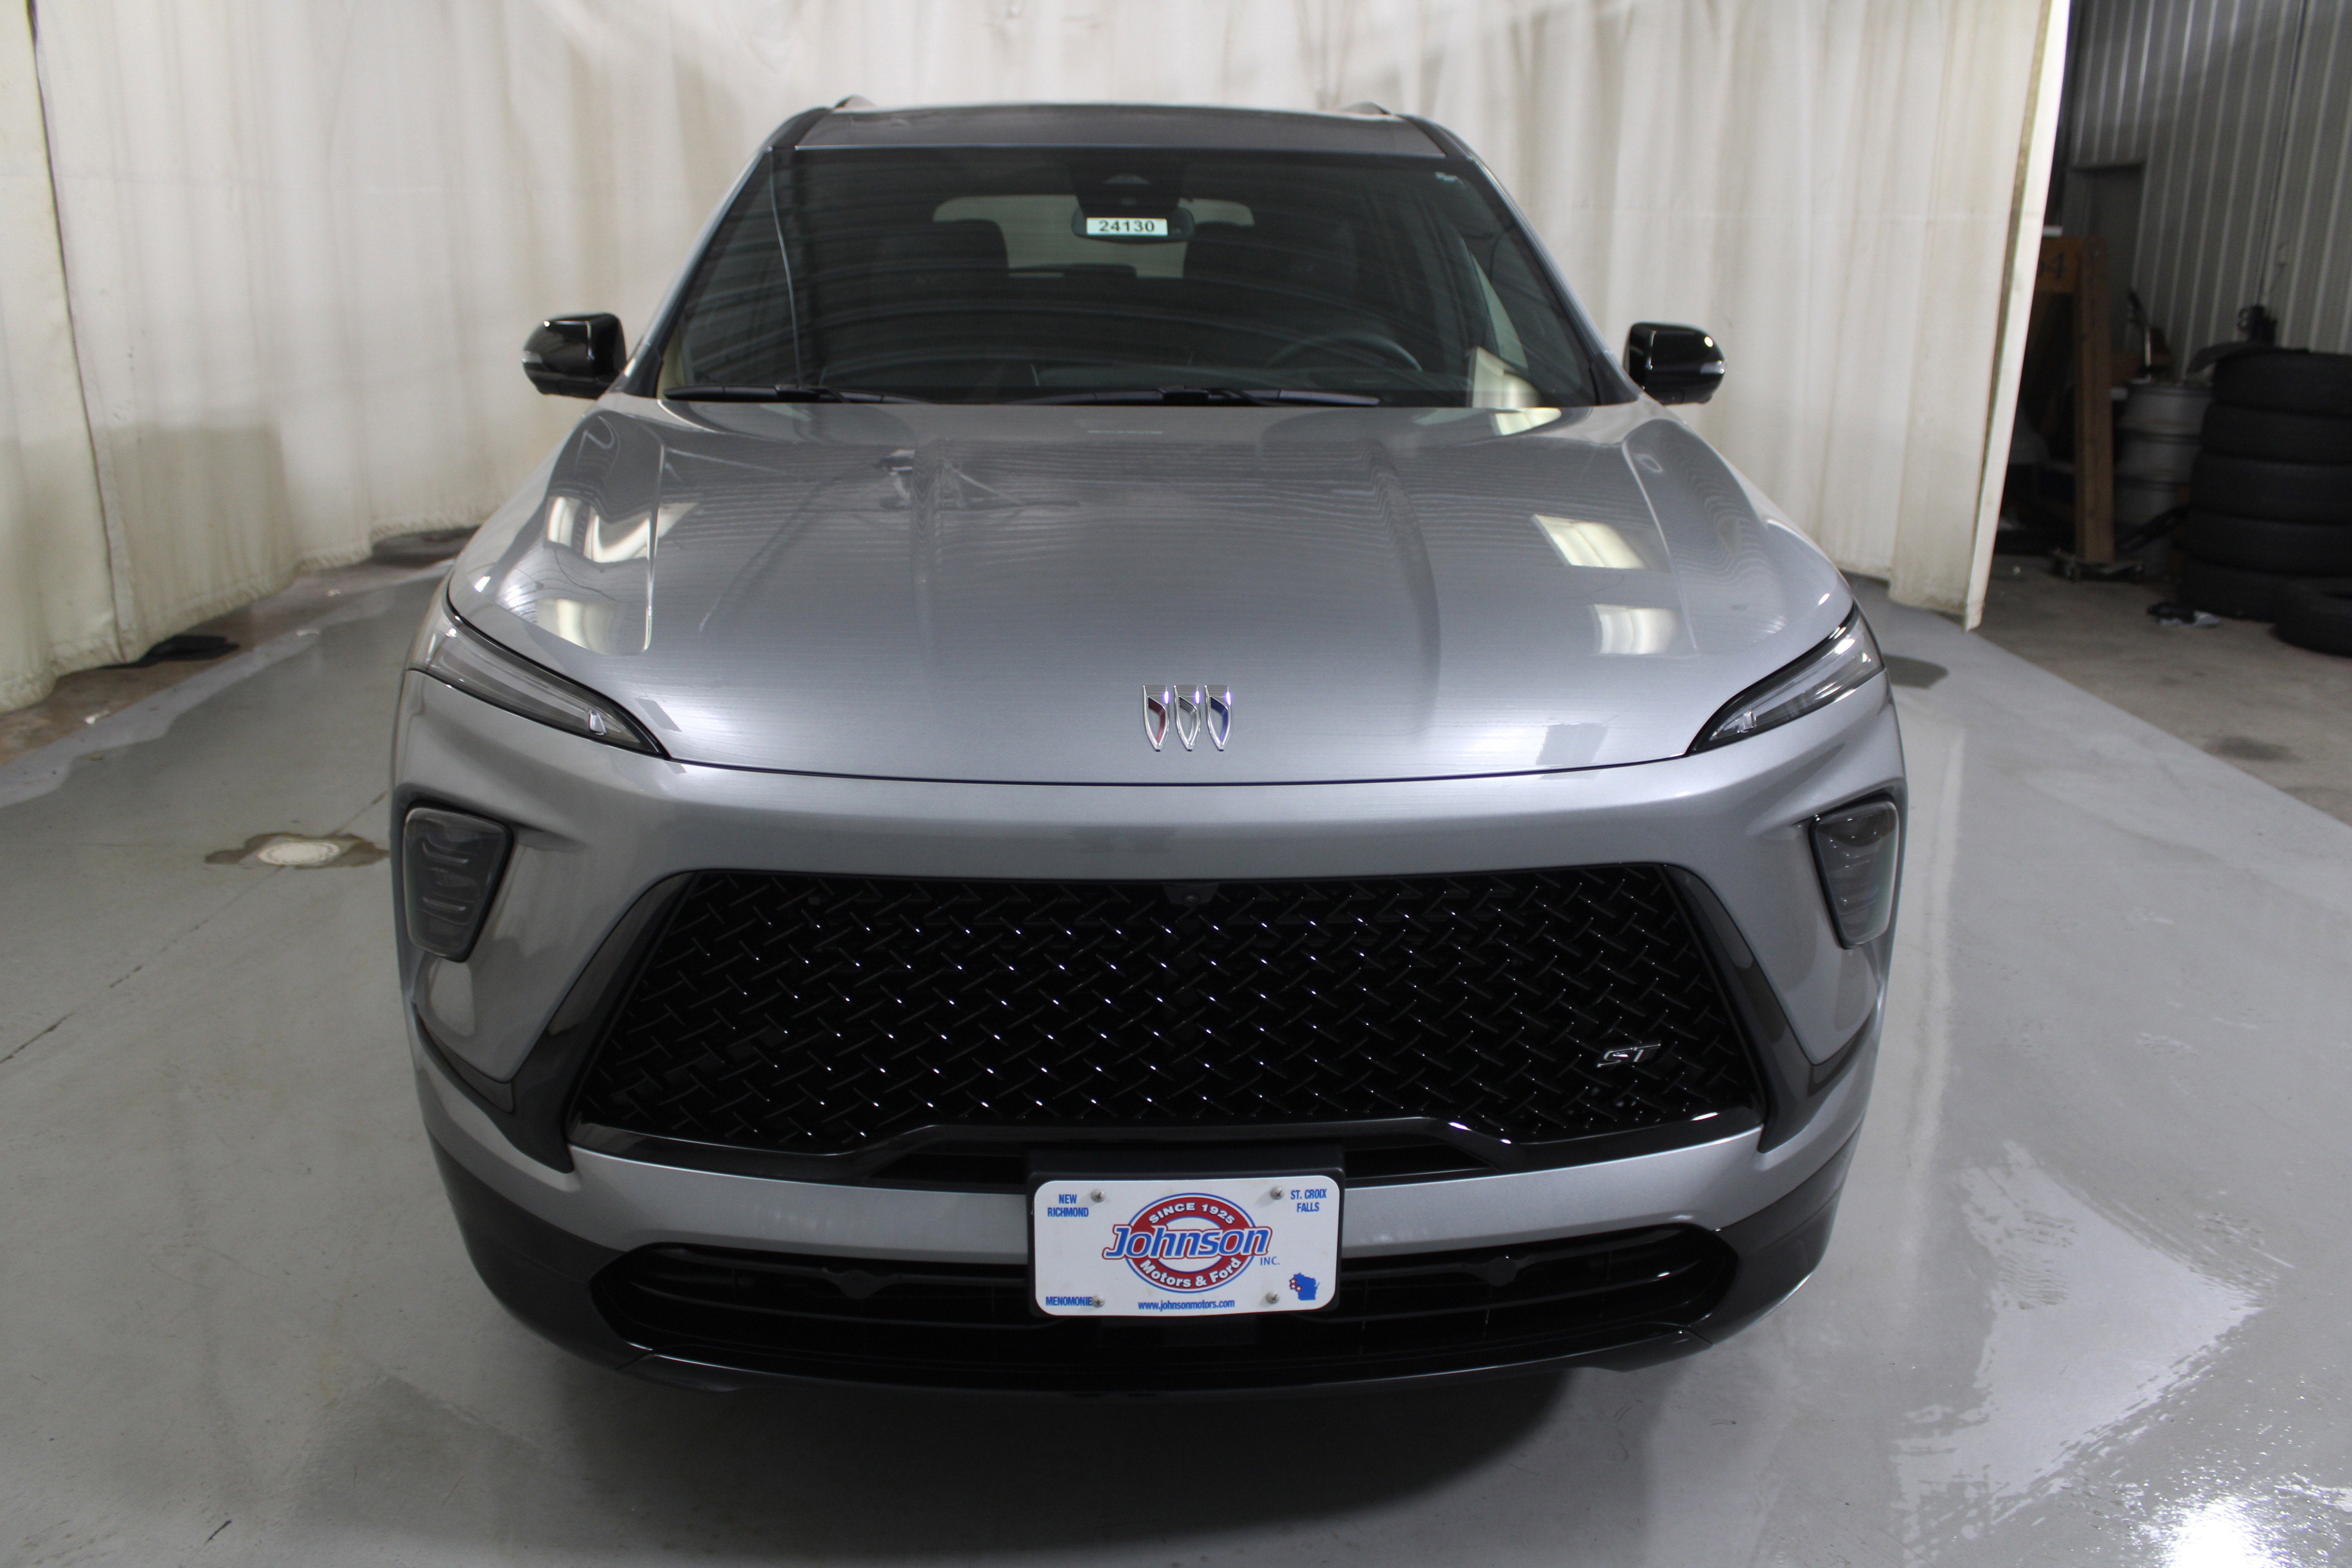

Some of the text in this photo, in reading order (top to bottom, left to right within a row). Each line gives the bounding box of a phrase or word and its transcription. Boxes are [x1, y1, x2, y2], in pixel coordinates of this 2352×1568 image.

[1099, 219, 1155, 232] 24130
[1596, 1040, 1662, 1070] ST
[1059, 1194, 1077, 1204] NEW
[1290, 1189, 1327, 1200] ST. CROIX
[1047, 1207, 1089, 1217] RICHMOND
[1297, 1202, 1319, 1212] FALLS
[1149, 1203, 1235, 1224] SINCE 1925
[1103, 1226, 1271, 1258] Johnson
[1260, 1256, 1280, 1266] INC.
[1140, 1257, 1242, 1287] Motors & Ford
[1046, 1296, 1093, 1306] MENOMONIE
[1138, 1300, 1235, 1312] www.johnsonmotors.com
